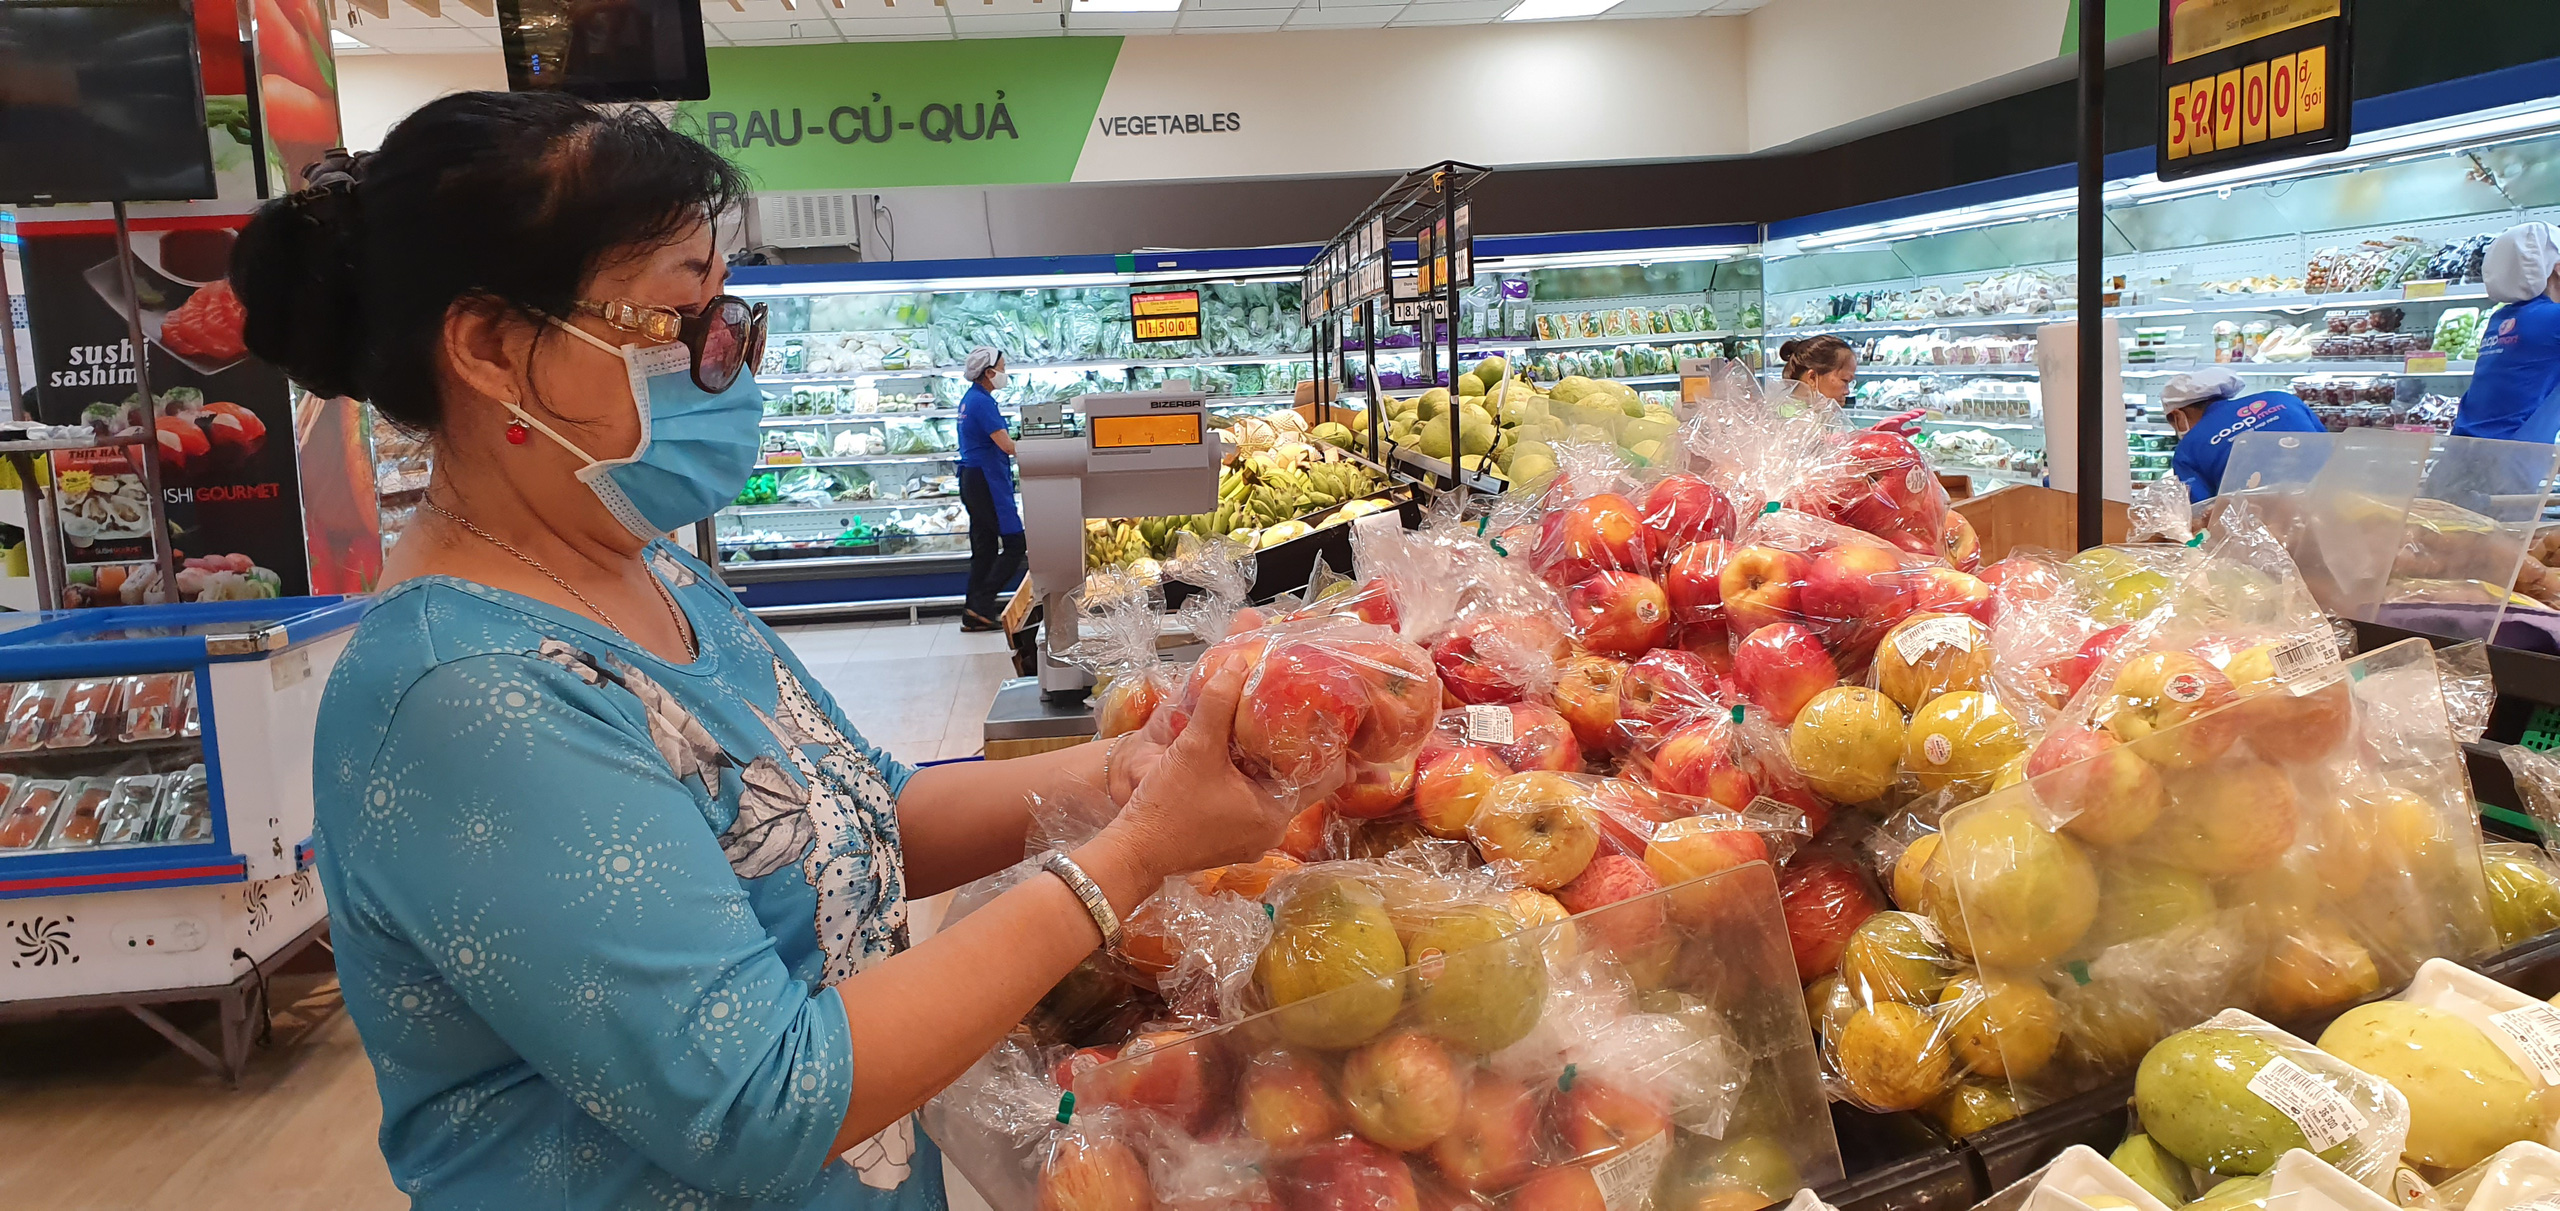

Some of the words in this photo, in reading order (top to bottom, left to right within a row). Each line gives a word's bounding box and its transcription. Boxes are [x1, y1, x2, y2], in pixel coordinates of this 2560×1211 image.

[1100, 113, 1241, 138] VEGETABLES
[1139, 321, 1185, 335] 11.500
[50, 365, 149, 387] sashim
[1151, 400, 1200, 409] BIZERBA
[197, 483, 280, 501] GOURMET
[2319, 1107, 2338, 1130] 36.300
